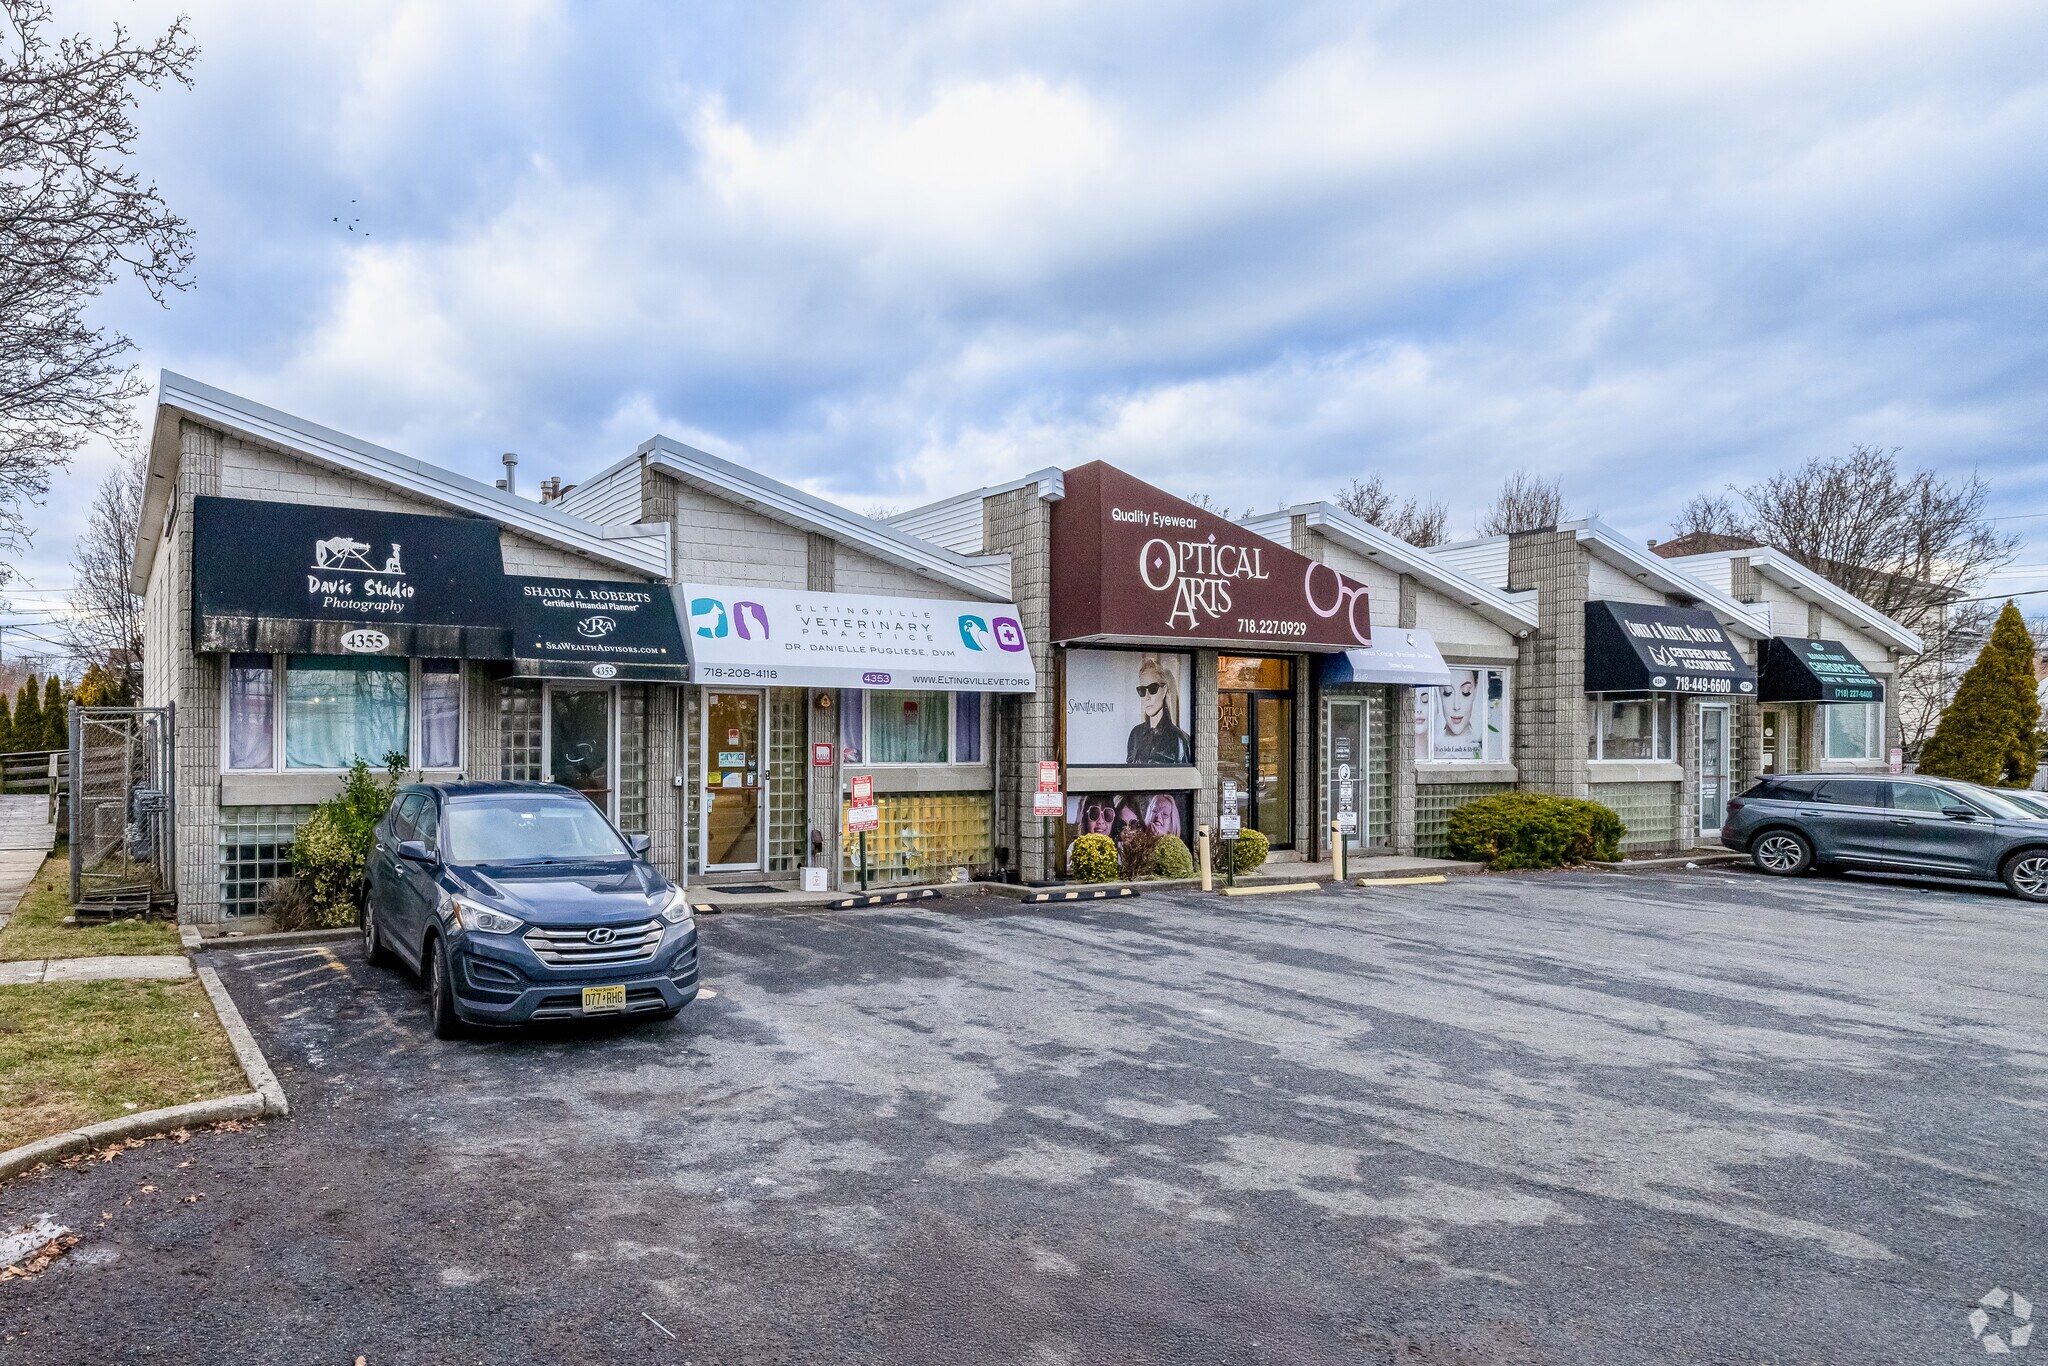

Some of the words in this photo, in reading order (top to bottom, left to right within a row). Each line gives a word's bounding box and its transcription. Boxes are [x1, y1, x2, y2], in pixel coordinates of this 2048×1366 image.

[1112, 508, 1150, 525] Quality
[1153, 511, 1197, 529] Eyewear
[1139, 534, 1270, 591] OPTICAL
[307, 575, 352, 595] Davis
[364, 579, 415, 598] Studio
[523, 586, 572, 598] SHAUN
[575, 589, 588, 599] A.
[590, 590, 651, 603] ROBERTS
[323, 596, 405, 614] Photography
[543, 599, 575, 608] Certified
[576, 600, 608, 610] Financial
[1165, 576, 1232, 630] ARTS
[795, 604, 931, 619] ELTINGVILLE
[800, 616, 930, 632] VETERINARY
[1238, 618, 1307, 636] 718.227.0929
[347, 633, 383, 648] 4355
[802, 628, 933, 642] PRACTICE
[785, 643, 806, 651] DR.
[809, 644, 866, 654] DANIELLE
[870, 646, 929, 657] PUGLIESE,
[932, 649, 955, 657] DVM
[1668, 646, 1707, 659] CERTIFIED
[1703, 649, 1732, 661] PUBLIC
[595, 666, 614, 676] 4355
[1682, 658, 1736, 672] ACCOUNTANTS
[703, 667, 778, 679] 718-208-4118
[864, 673, 890, 683] 4353
[912, 675, 1030, 686] WWW.ELTINGVILLEVET.ORG
[1675, 676, 1731, 693] 718-449-6600
[585, 993, 601, 1006] D77
[607, 991, 623, 1004] RHG
